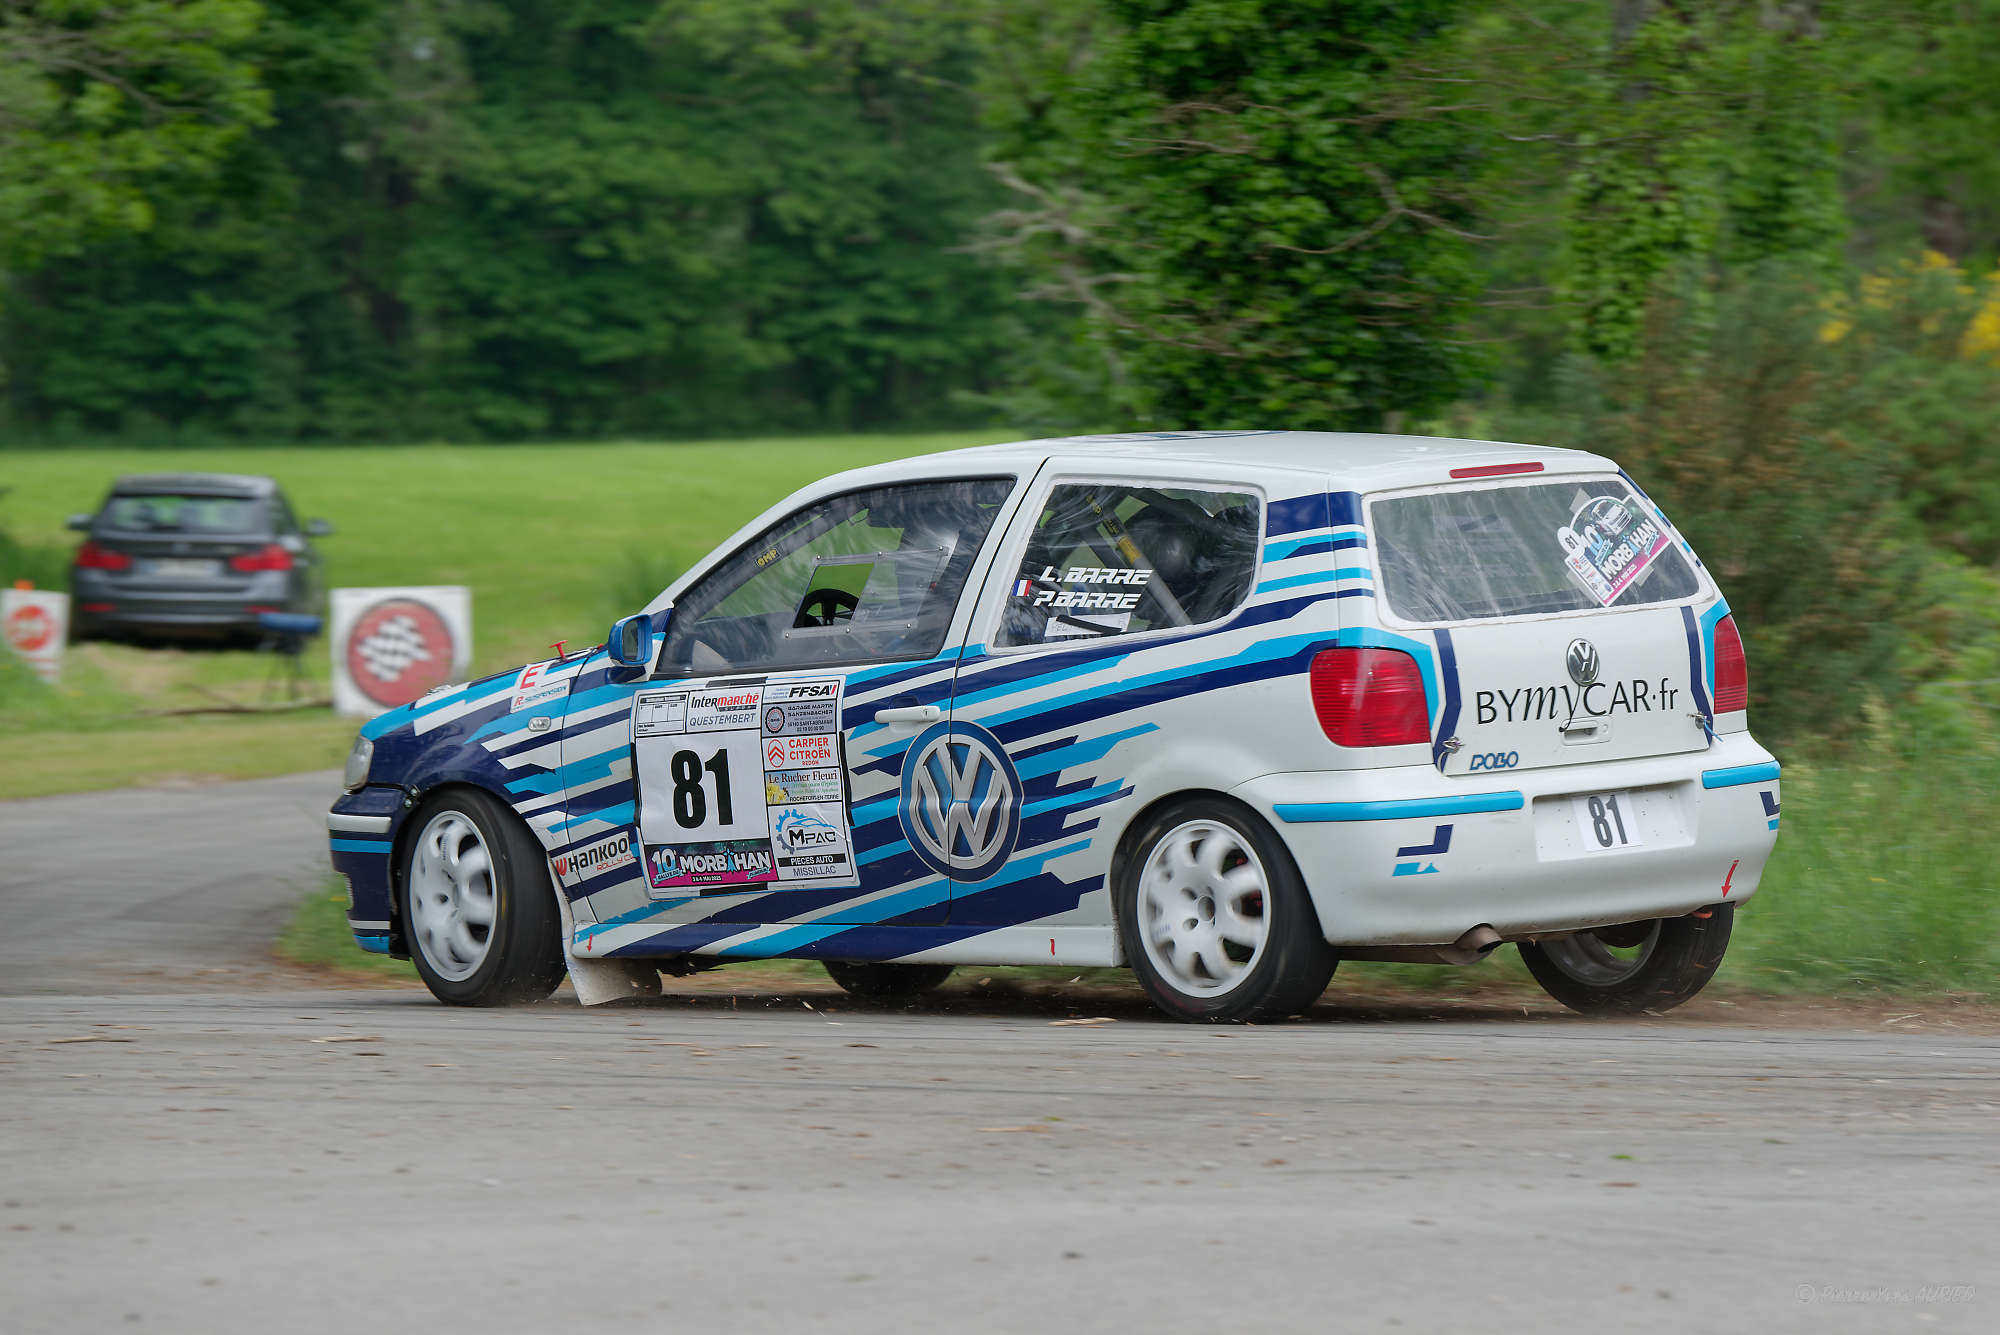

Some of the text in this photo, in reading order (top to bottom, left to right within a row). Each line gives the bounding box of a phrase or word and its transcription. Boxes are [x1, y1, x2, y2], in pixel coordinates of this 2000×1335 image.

[1565, 534, 1579, 549] 81
[789, 685, 830, 698] FFSA
[689, 712, 757, 727] QUESTEMBERT
[788, 736, 829, 749] CARPIER
[789, 746, 831, 761] CITROËN
[1468, 750, 1520, 771] POLO
[767, 769, 838, 784] Le Rucher Fleuri
[670, 748, 734, 829] 81
[1587, 794, 1629, 848] 81
[788, 828, 837, 846] MPAC
[679, 850, 772, 874] MORBIHAN
[790, 855, 834, 866] PIECES AUTO
[792, 865, 837, 877] MISSILLAC
